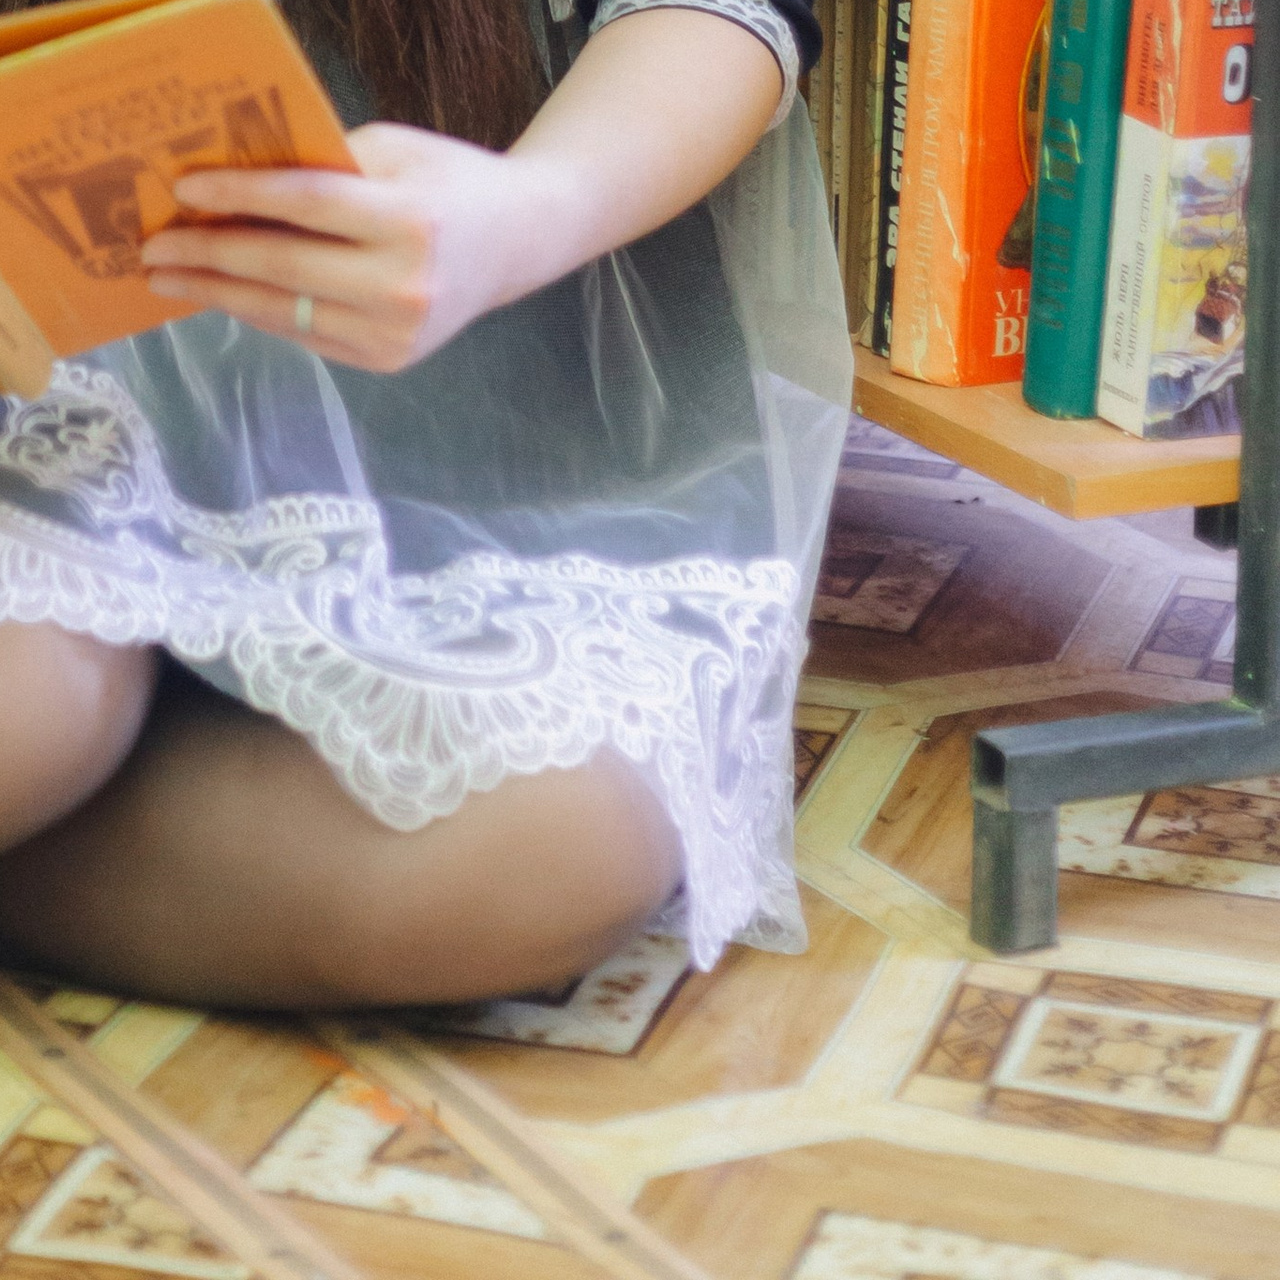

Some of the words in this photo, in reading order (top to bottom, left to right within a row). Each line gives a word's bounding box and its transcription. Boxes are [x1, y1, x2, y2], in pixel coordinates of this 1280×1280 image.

[1136, 172, 1153, 235] ОСТРОВ
[991, 316, 1027, 358] В
[1125, 240, 1148, 372] ТАИНСТВЕННЫЙ
